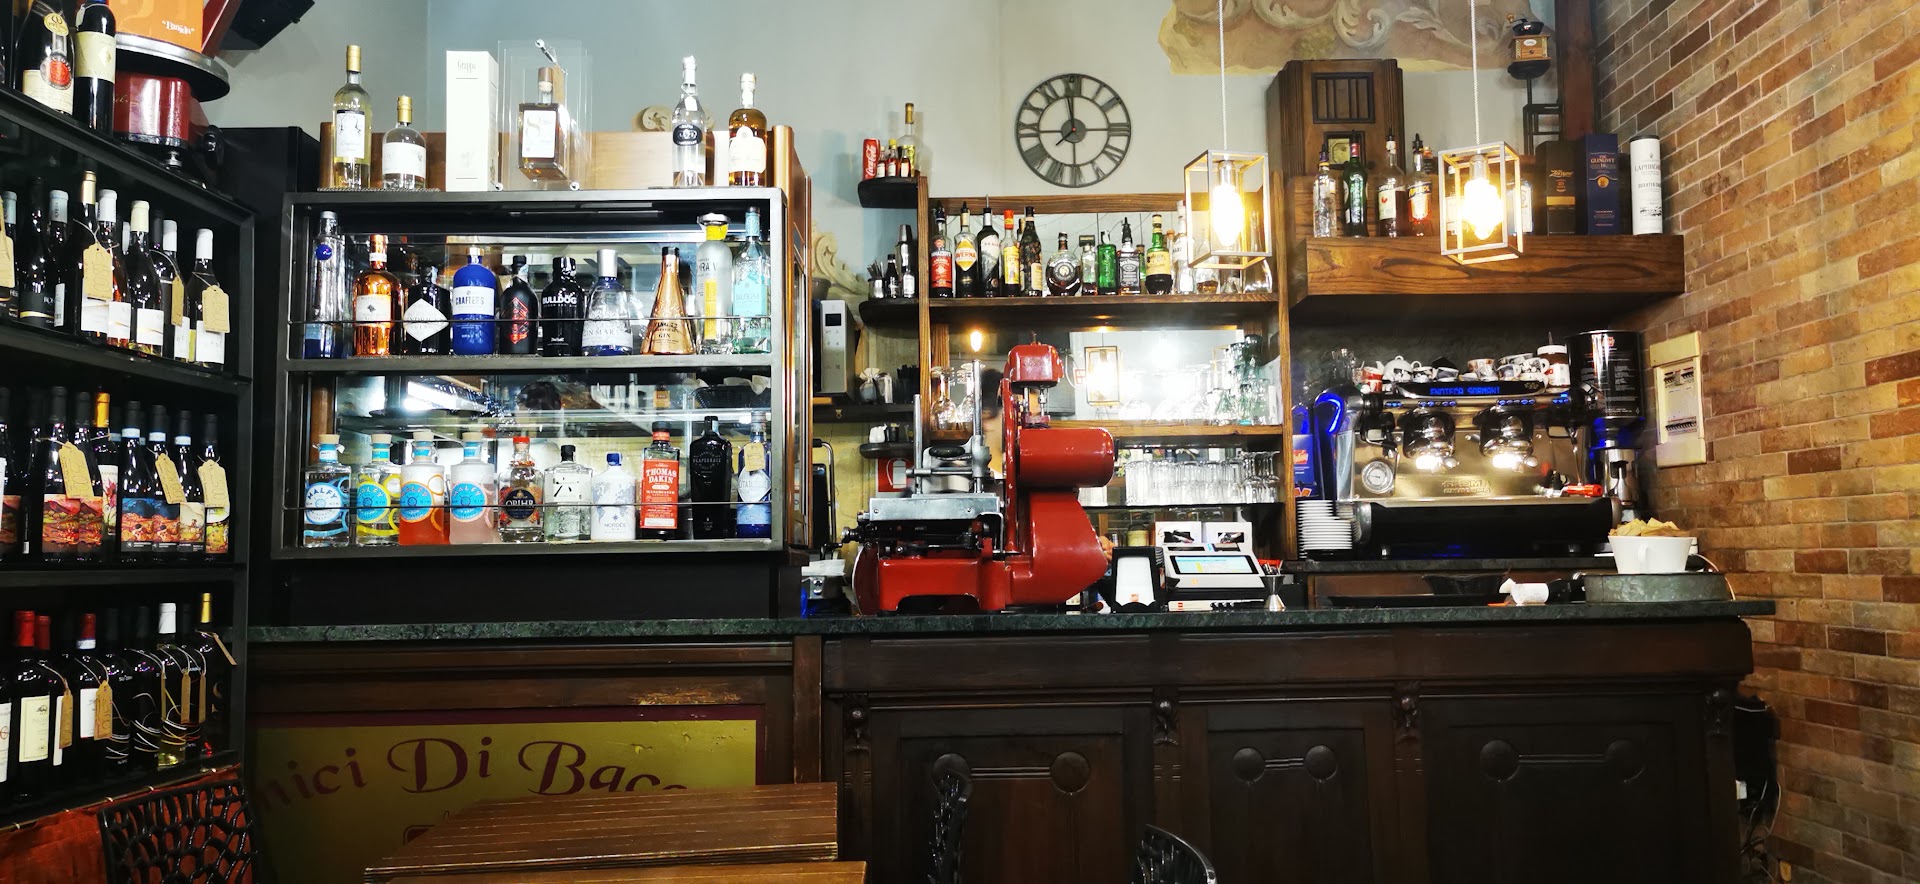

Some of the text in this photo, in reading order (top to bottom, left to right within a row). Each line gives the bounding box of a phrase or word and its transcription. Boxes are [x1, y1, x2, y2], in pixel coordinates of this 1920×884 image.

[1634, 163, 1662, 172] LAPHROA
[455, 296, 485, 306] CRAFTERS
[542, 295, 578, 305] BULLDOG
[1430, 387, 1464, 395] ENOTECA
[645, 468, 677, 478] THOMAS
[648, 476, 675, 484] DAKIN
[307, 487, 338, 500] MALFY
[358, 486, 384, 500] ALFY
[386, 736, 494, 793] Di
[517, 740, 689, 796] Bac
